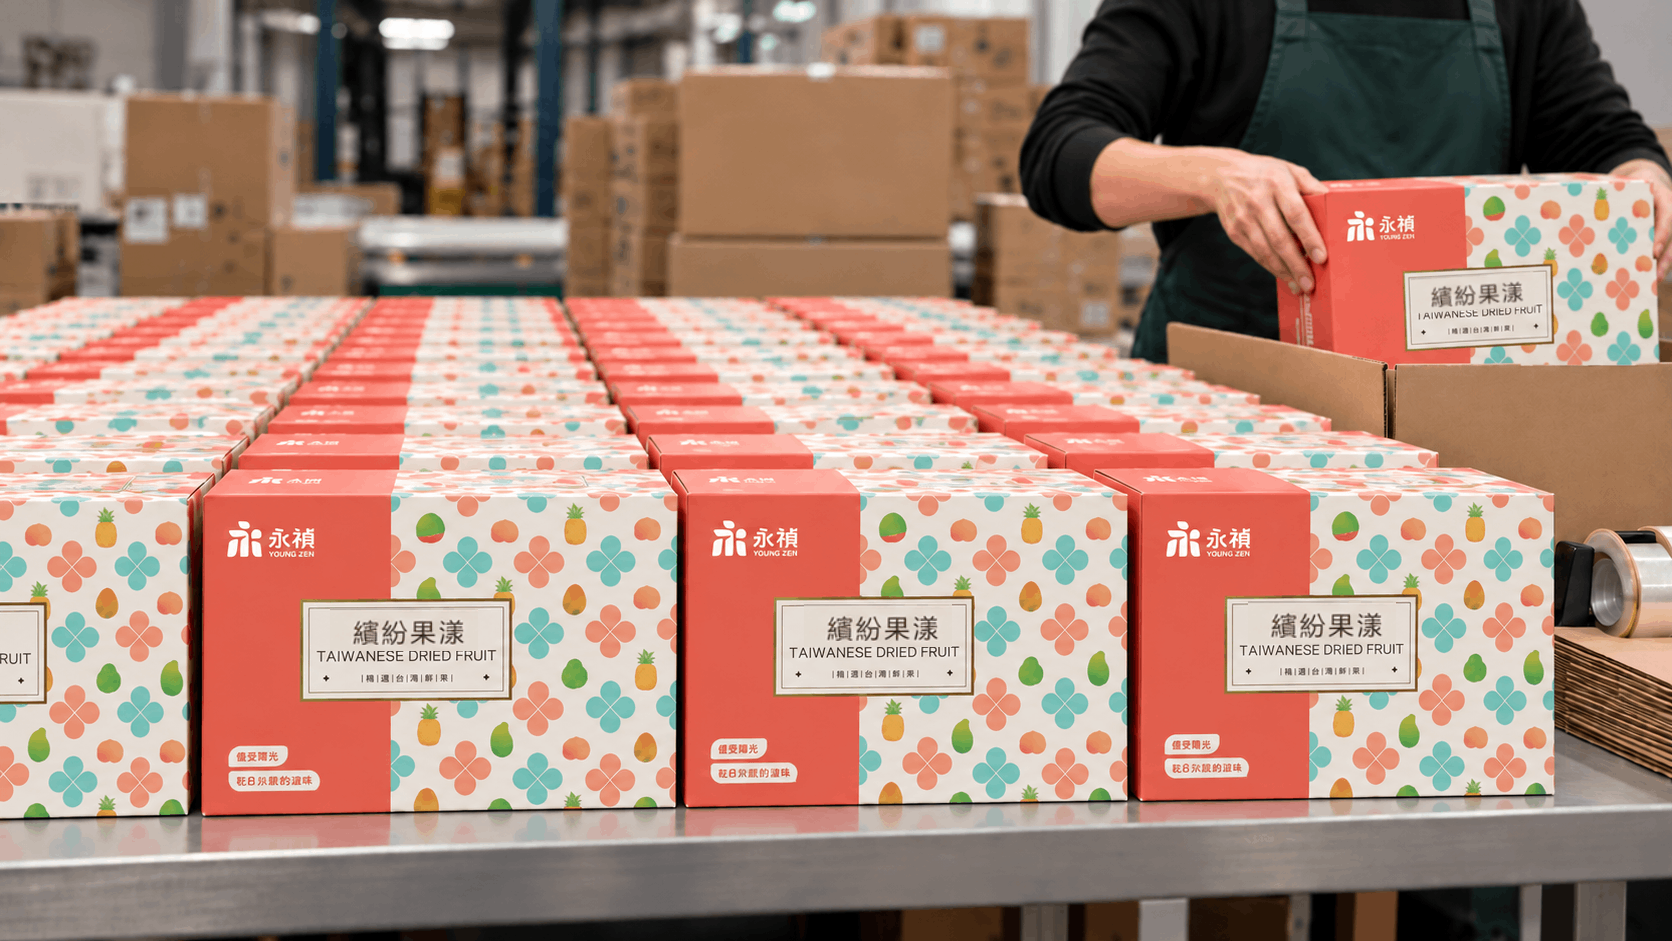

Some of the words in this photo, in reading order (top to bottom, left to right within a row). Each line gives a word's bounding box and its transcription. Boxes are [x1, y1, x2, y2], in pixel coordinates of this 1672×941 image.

[1379, 215, 1414, 233] 永禎
[1431, 282, 1523, 308] 繽紛果漾
[269, 528, 315, 549] 永禎
[753, 527, 798, 549] 永禎
[1206, 528, 1250, 549] 永禎
[269, 550, 297, 558] YOUNG
[298, 550, 315, 558] ZEN
[753, 549, 780, 557] YOUNG
[782, 549, 798, 557] ZEN
[1207, 550, 1233, 558] YOUNG
[1235, 550, 1250, 558] ZEN
[353, 619, 464, 645] 繽紛果漾
[826, 616, 937, 642] 繽紛果漾
[1271, 612, 1382, 639] 繽紛果漾
[317, 651, 404, 662] TAIWANESE
[409, 651, 451, 662] DRIED
[456, 650, 497, 661] FRUIT
[789, 647, 872, 659] TAIWANESE
[876, 646, 917, 658] DRIED
[920, 645, 960, 657] FRUIT
[1240, 644, 1320, 656] TAIWANESE
[1323, 644, 1363, 656] DRIED
[1367, 643, 1405, 655] FRUIT
